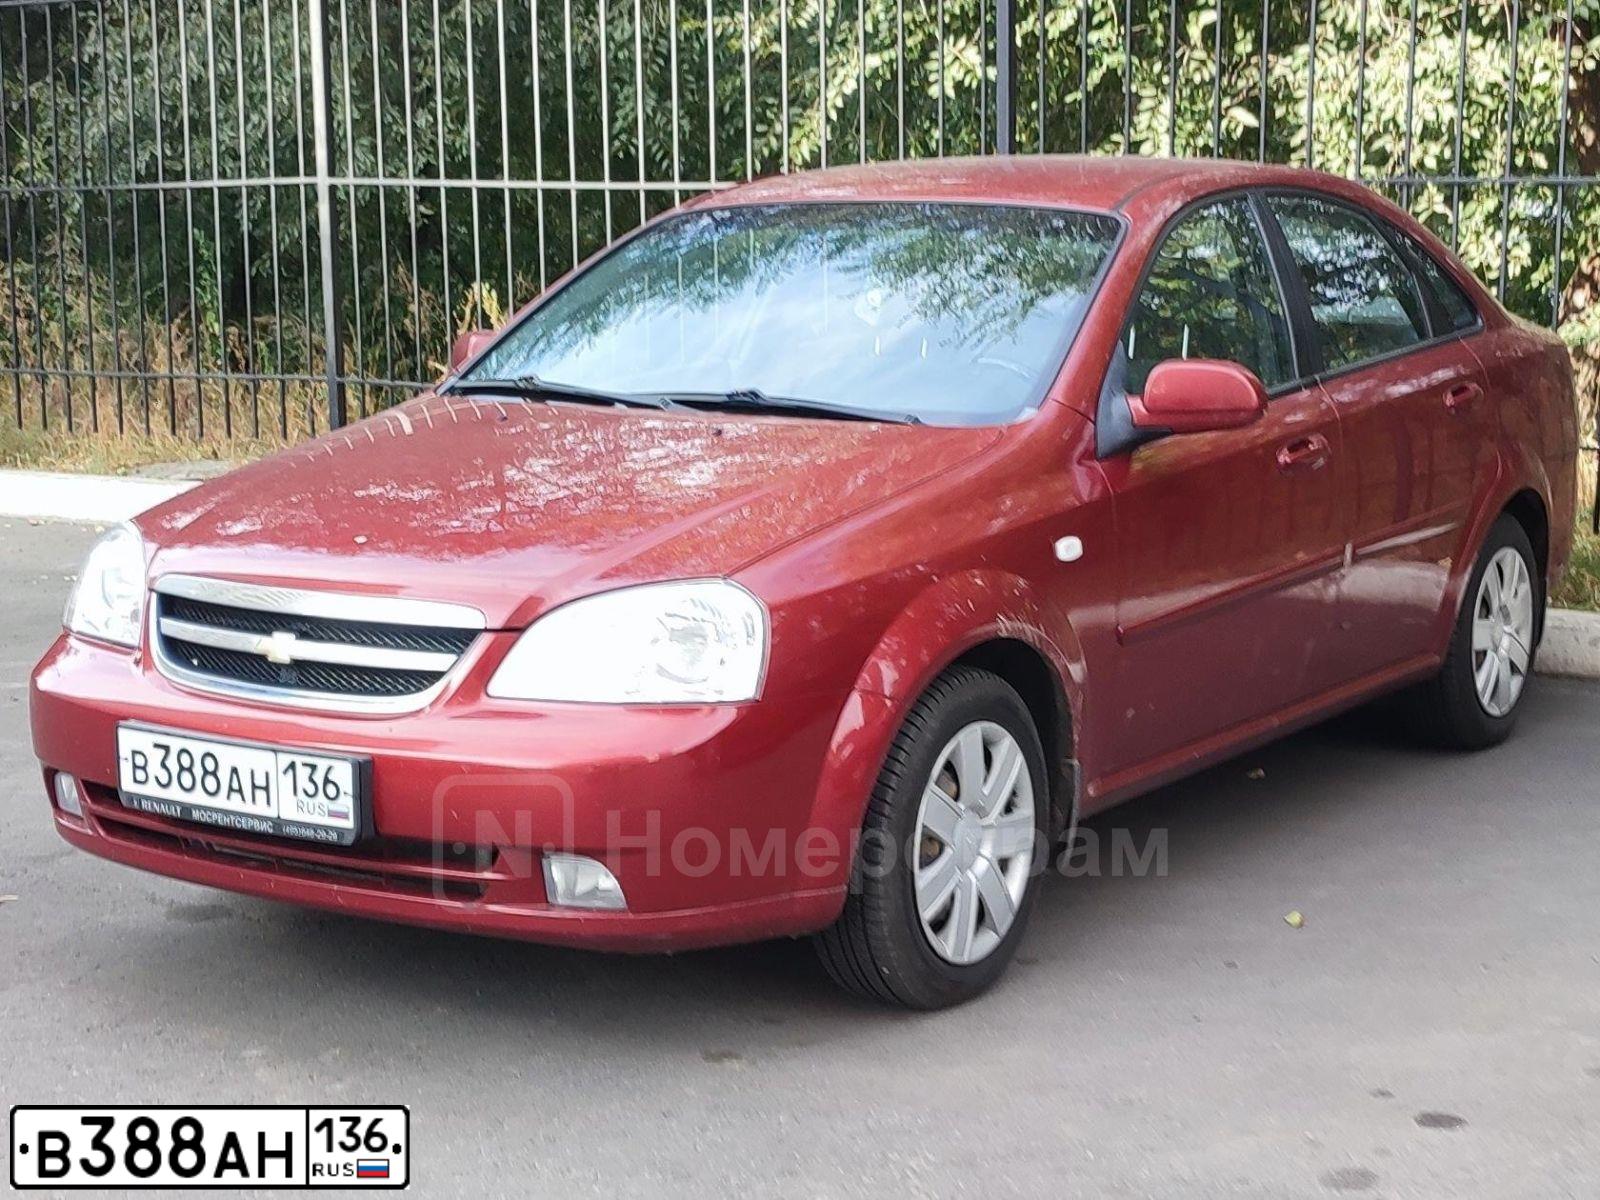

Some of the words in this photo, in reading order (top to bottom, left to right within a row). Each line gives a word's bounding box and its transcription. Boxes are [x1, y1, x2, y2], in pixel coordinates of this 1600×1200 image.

[282, 759, 341, 801] 136
[141, 798, 182, 819] RENAULT
[296, 798, 327, 818] RUS
[191, 807, 274, 834] МОСРЕНТСЕРВИС
